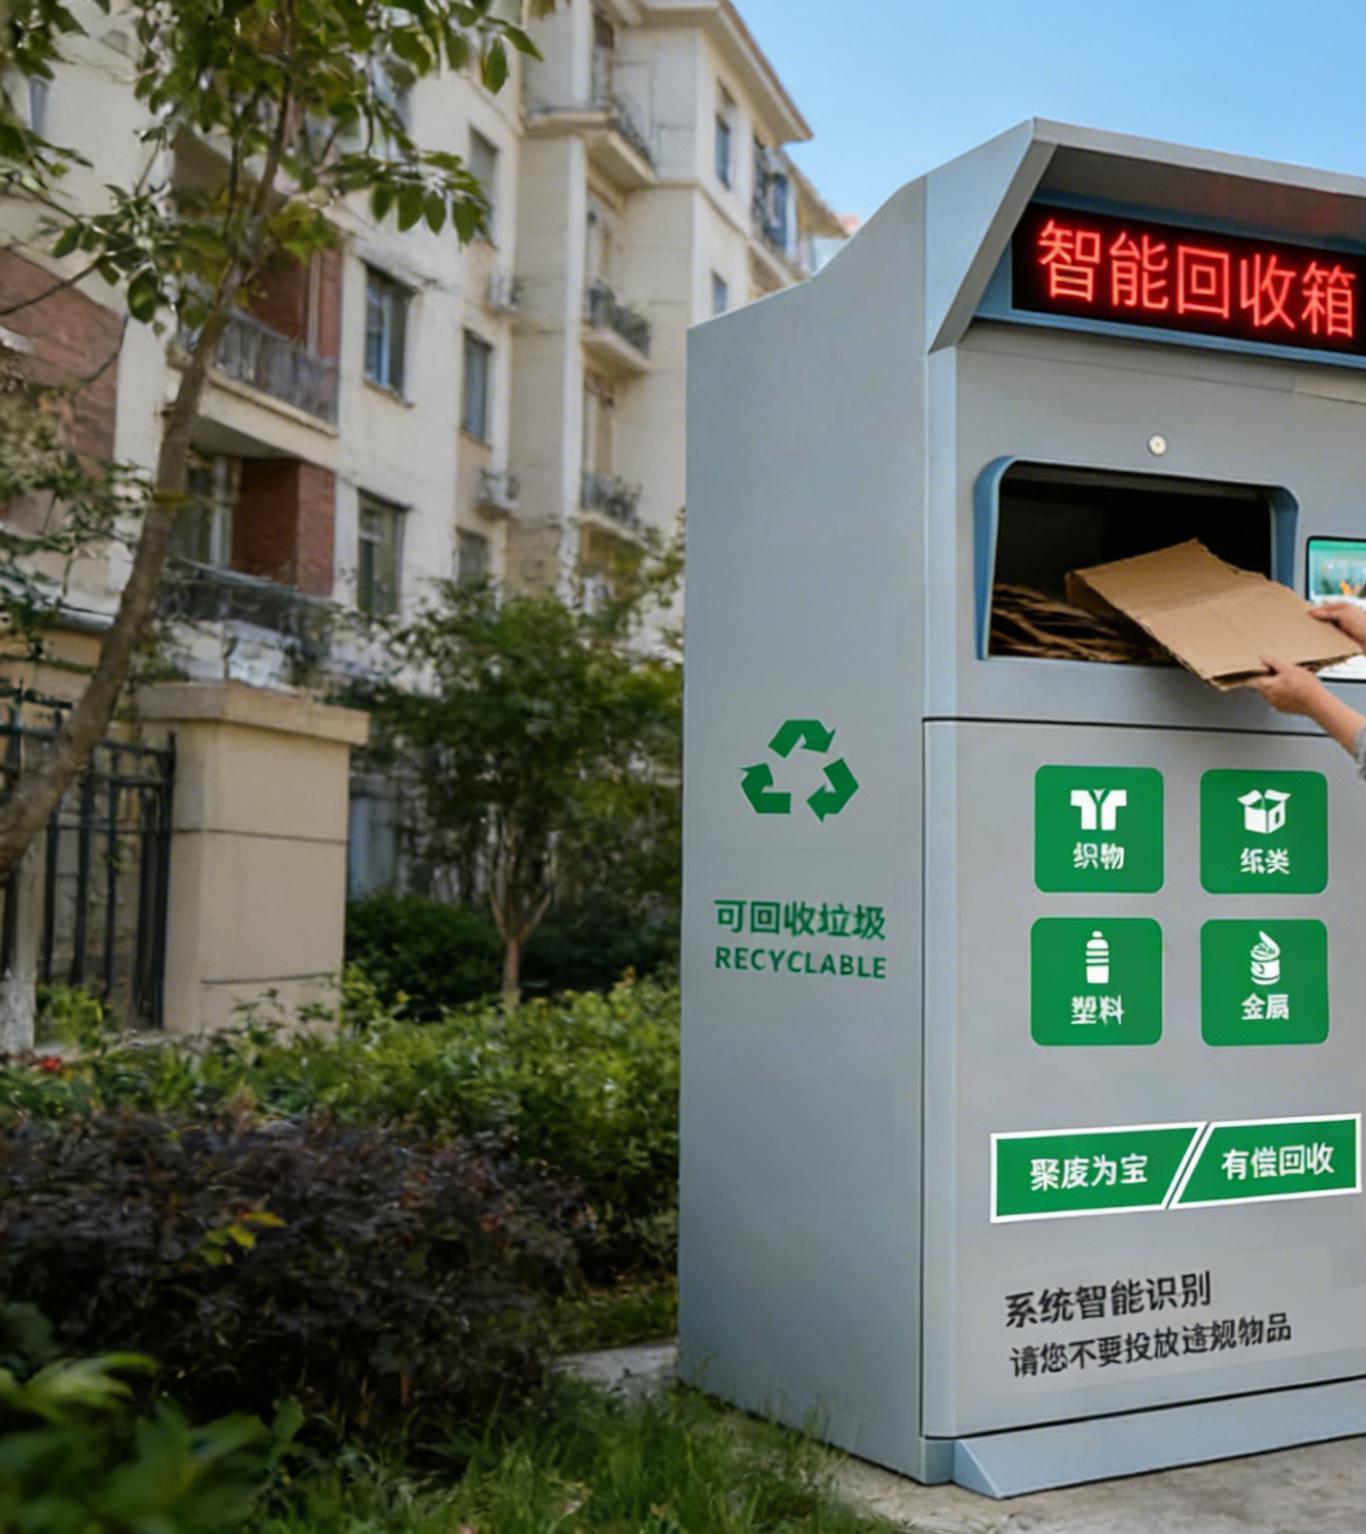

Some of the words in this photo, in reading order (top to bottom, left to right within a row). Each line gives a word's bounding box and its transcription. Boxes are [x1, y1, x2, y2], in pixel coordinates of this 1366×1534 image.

[1037, 219, 1356, 338] 智能回收箱
[1073, 842, 1125, 870] 织物
[1240, 847, 1290, 874] 纸类
[713, 899, 886, 940] 可回收垃圾
[715, 946, 887, 979] RECYCLABLE
[1071, 995, 1124, 1025] 塑料
[1221, 1142, 1335, 1180] 有偿回收
[1005, 1269, 1212, 1328] 系统智能识别
[1009, 1311, 1292, 1378] 请您不要投放违规物品
